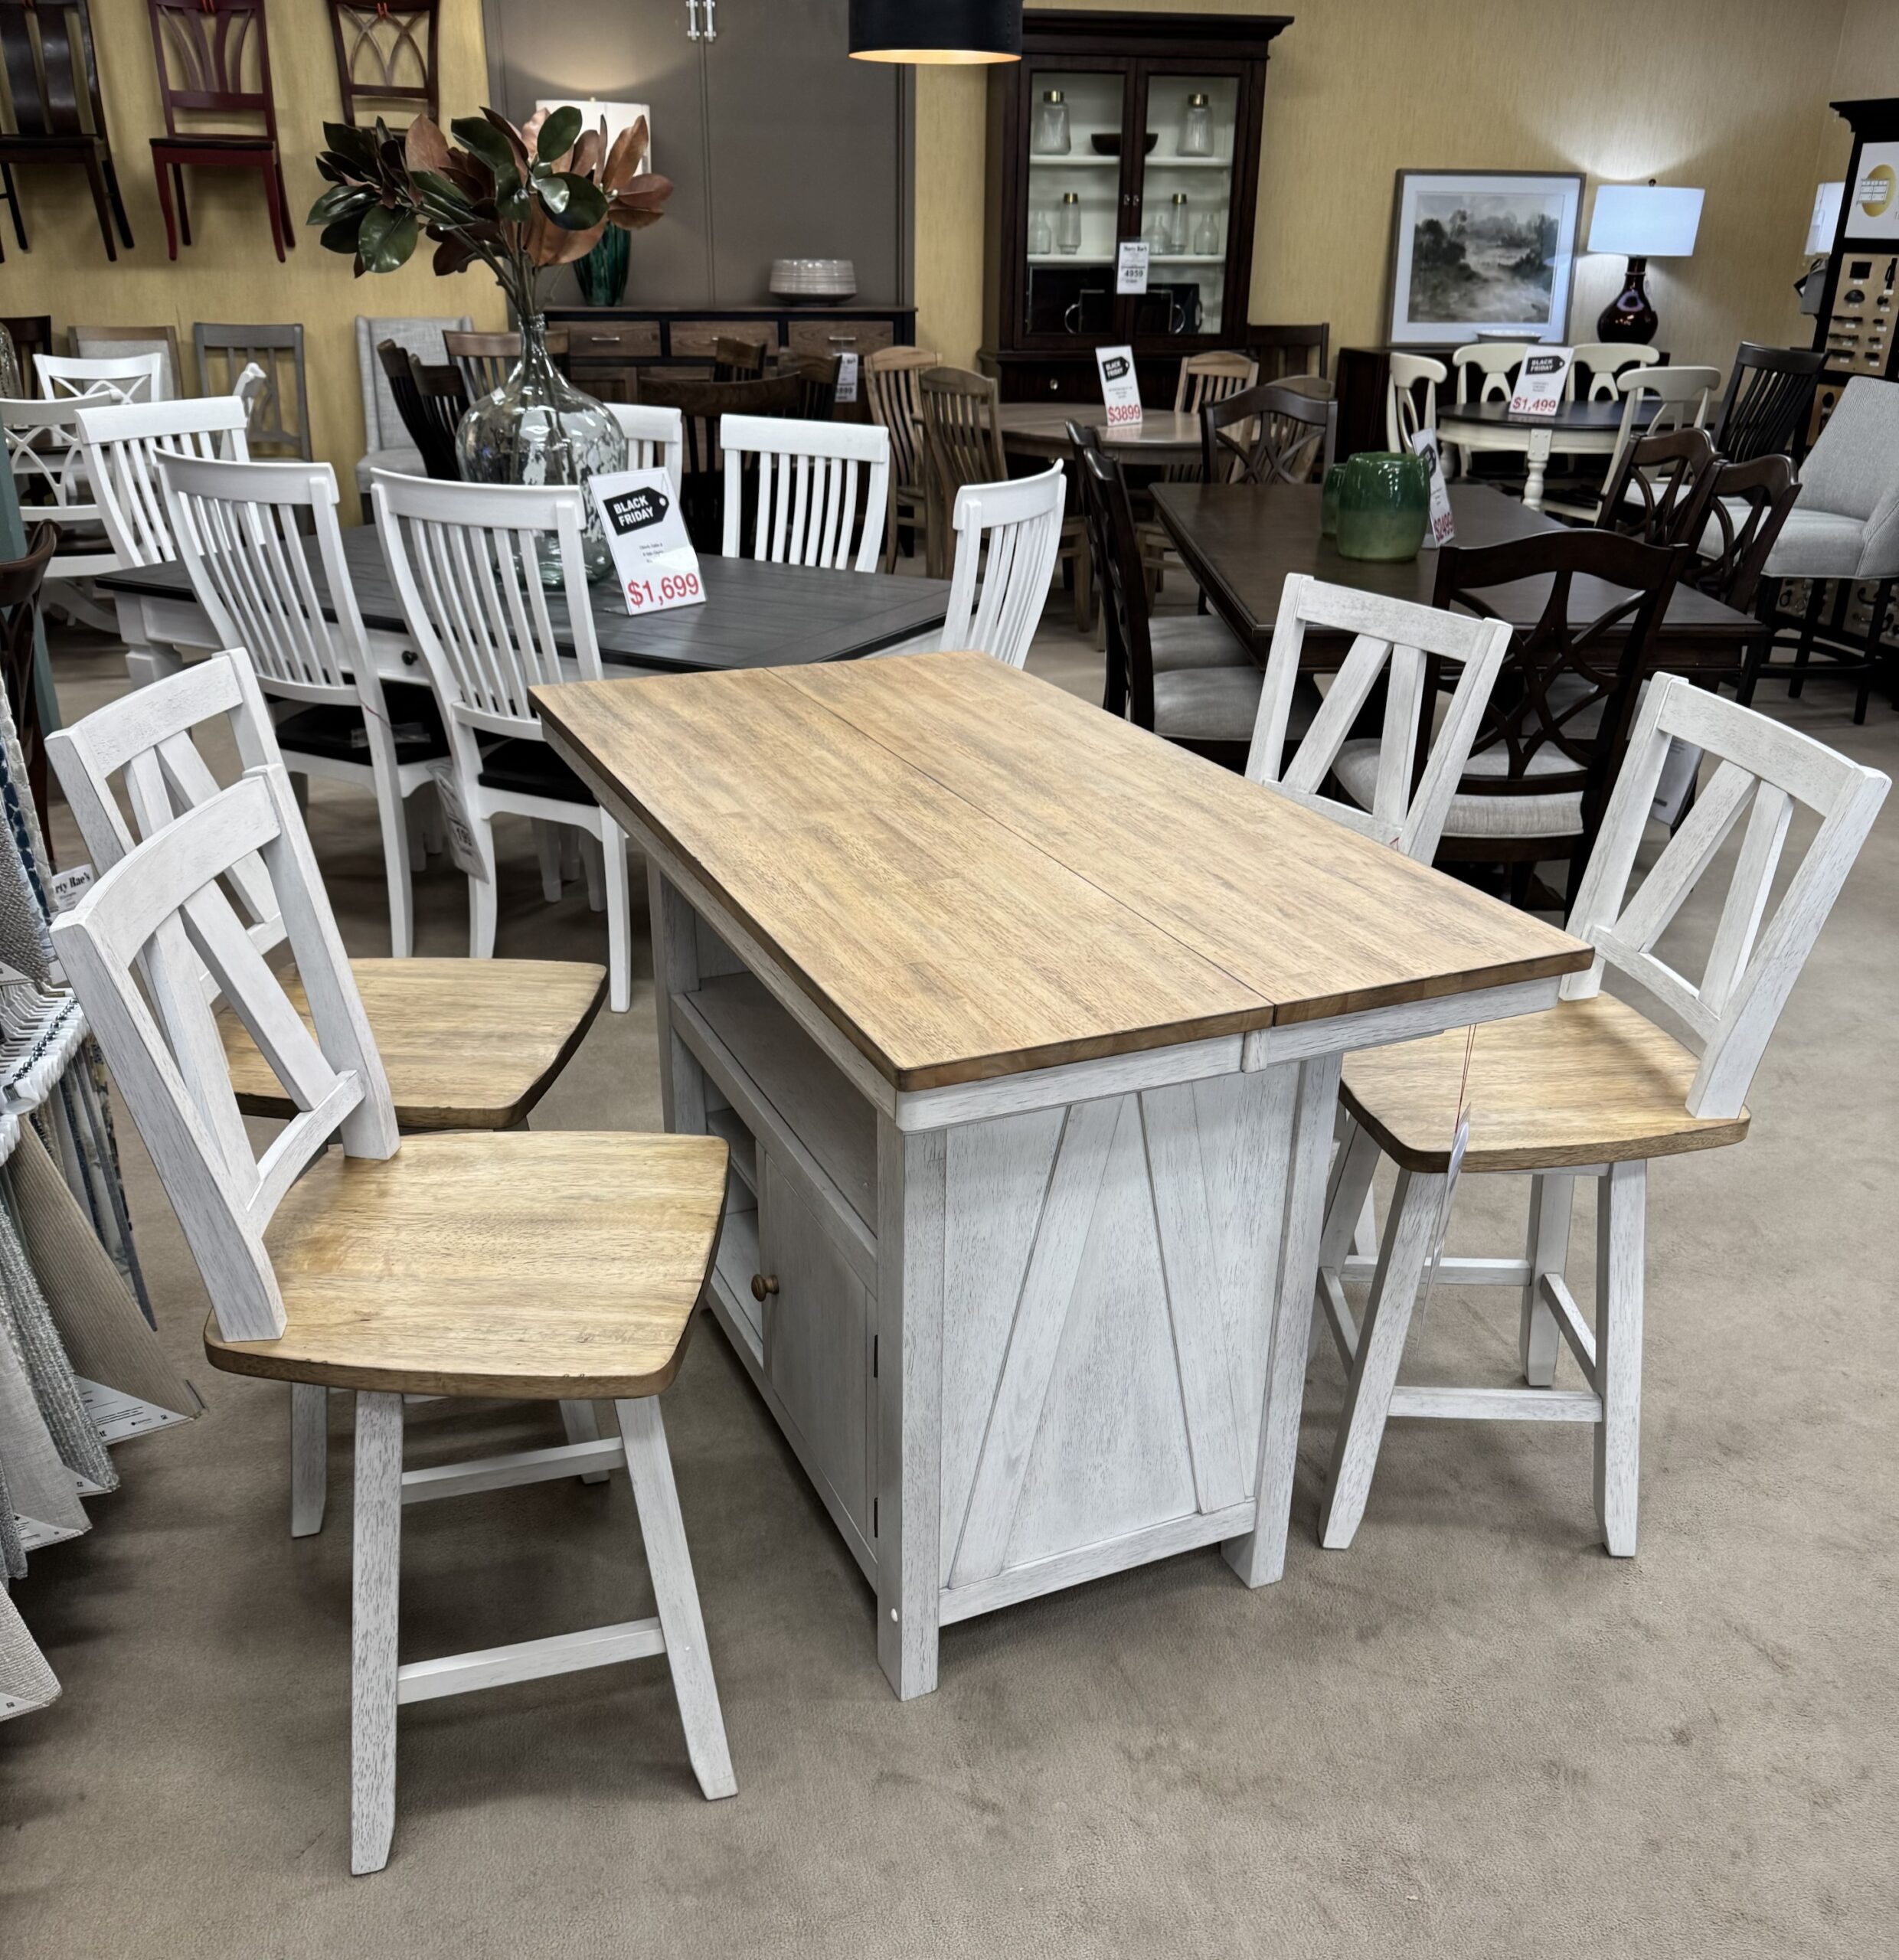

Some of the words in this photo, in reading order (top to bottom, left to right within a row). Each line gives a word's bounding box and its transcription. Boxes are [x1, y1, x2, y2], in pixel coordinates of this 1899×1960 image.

[1106, 367, 1123, 378] FRIDAY
[1108, 404, 1141, 423] $3899
[1512, 397, 1556, 412] $1,499
[613, 495, 649, 514] BLACK
[618, 506, 654, 526] FRIDAY
[627, 573, 699, 608] $1,699
[55, 883, 67, 894] rty
[69, 872, 90, 888] Rae's
